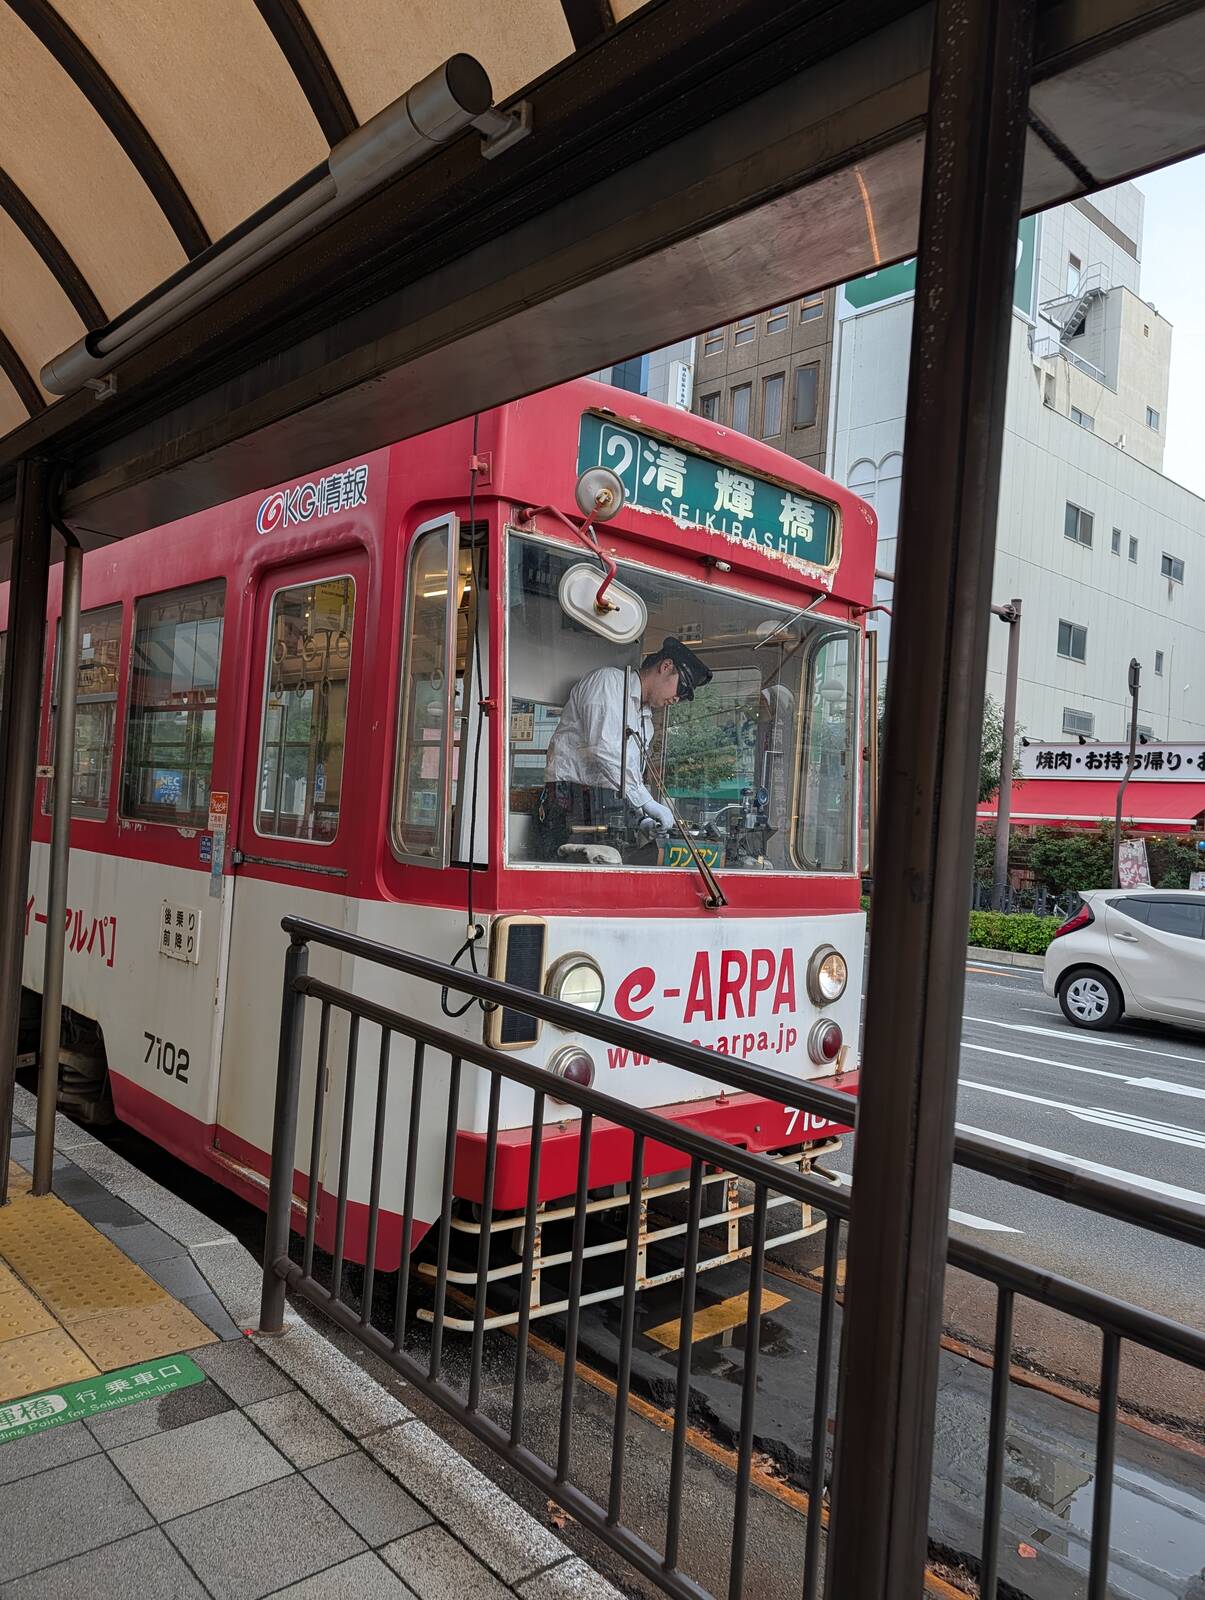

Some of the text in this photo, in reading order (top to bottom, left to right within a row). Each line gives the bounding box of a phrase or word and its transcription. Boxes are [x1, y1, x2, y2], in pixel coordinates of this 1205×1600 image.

[606, 434, 633, 498] 2
[661, 497, 797, 556] SEIKIBASHI
[614, 947, 796, 1023] e-ARPA
[144, 1031, 190, 1084] 7102
[783, 1106, 838, 1136] 710
[28, 1415, 64, 1431] Point
[67, 1408, 86, 1418] for
